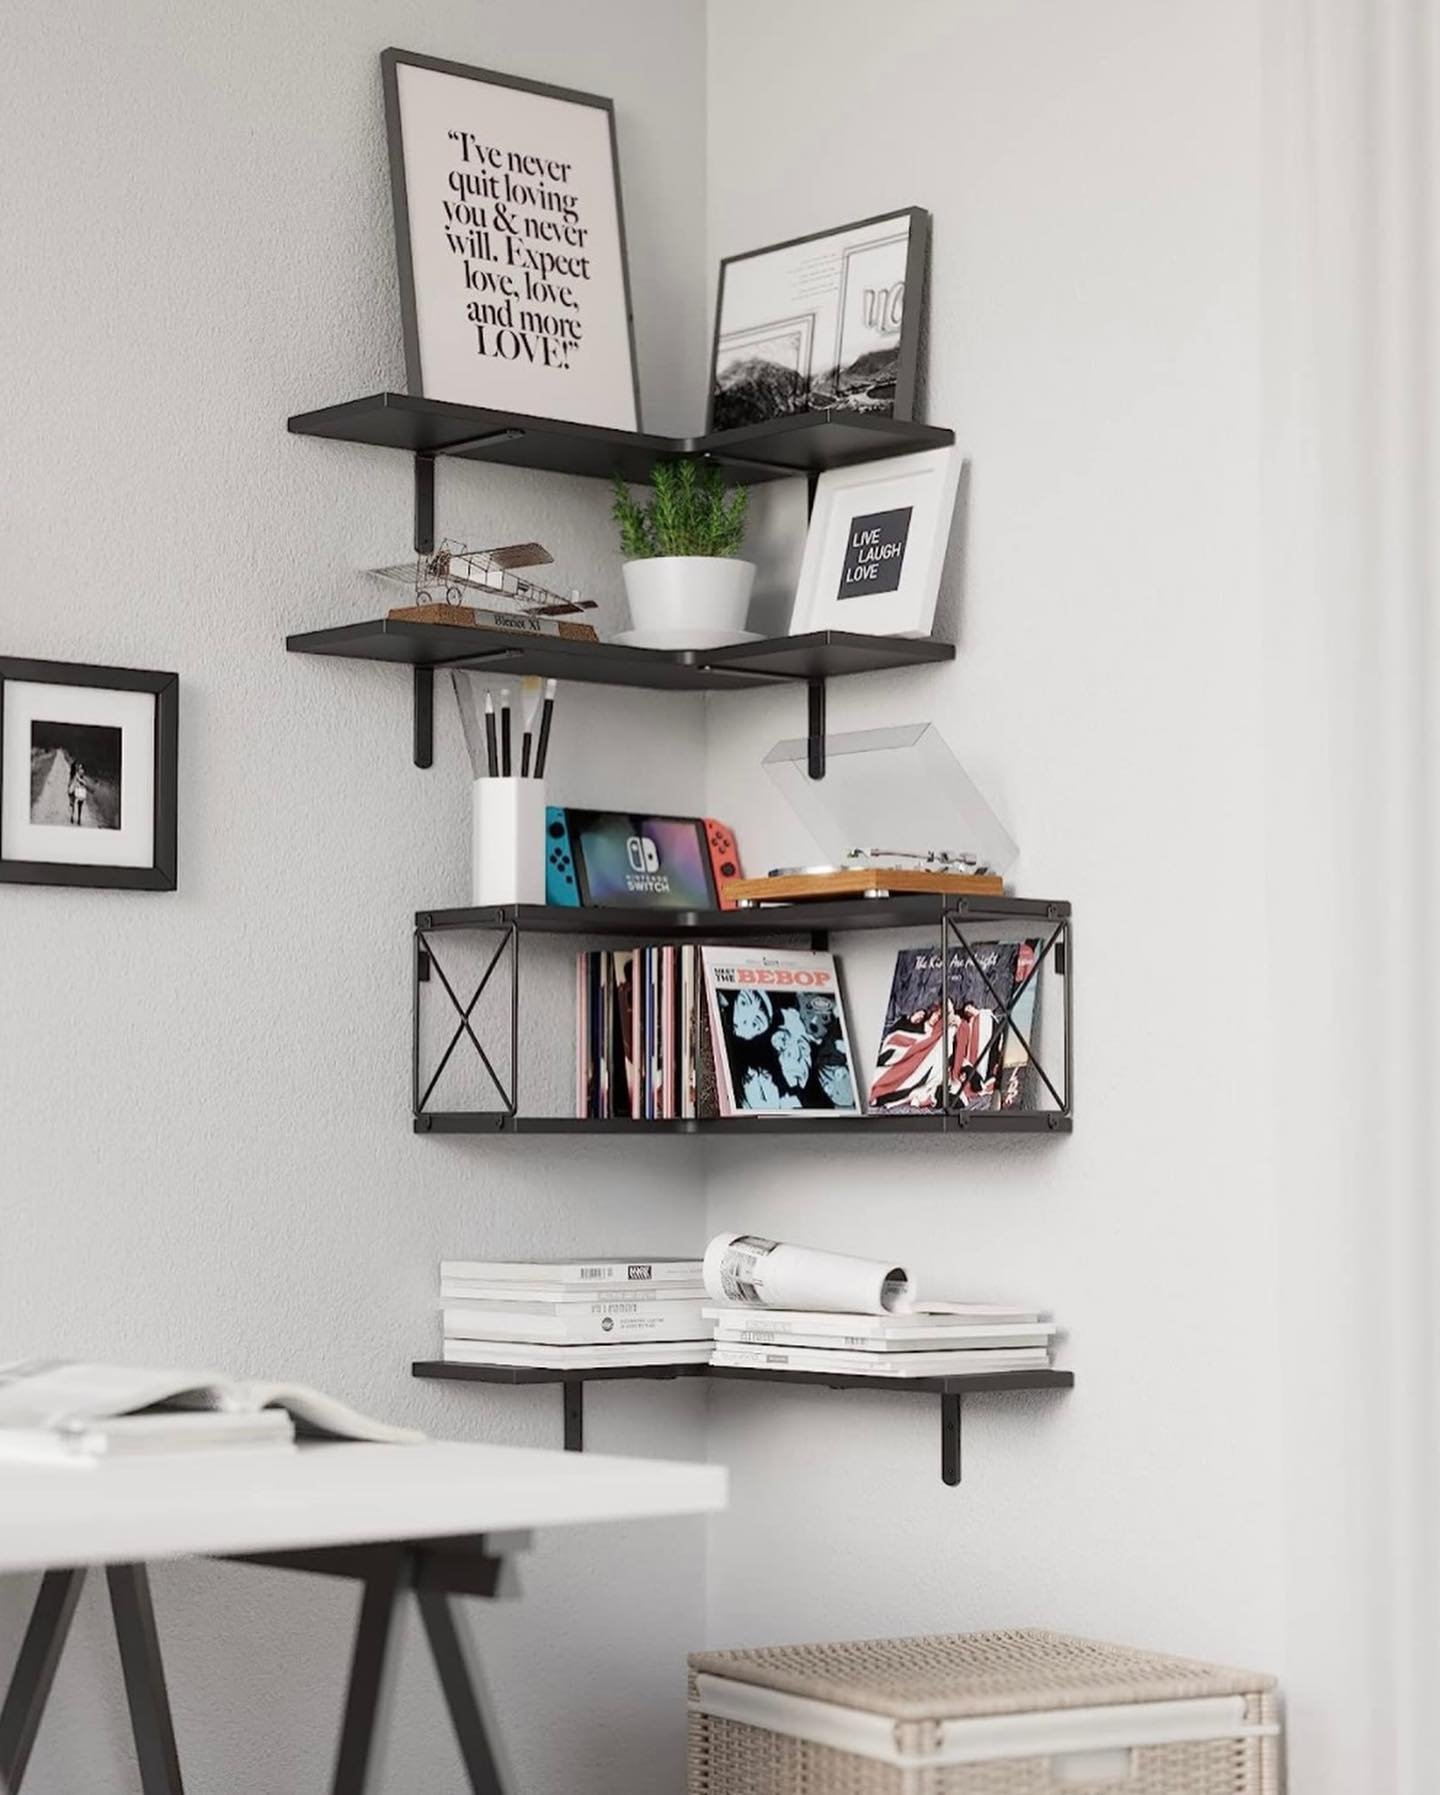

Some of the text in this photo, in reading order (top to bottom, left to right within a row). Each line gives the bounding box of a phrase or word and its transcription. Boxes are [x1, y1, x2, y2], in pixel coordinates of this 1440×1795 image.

[507, 152, 571, 183] never
[448, 169, 578, 225] quit loving
[442, 200, 588, 248] you & never
[446, 229, 590, 280] will. Expect
[464, 260, 579, 313] love, love,
[467, 299, 582, 340] and more
[853, 528, 881, 548] LIVE
[858, 542, 902, 563] LAUGH
[846, 563, 880, 583] LOVE
[627, 881, 670, 893] SWITCH
[716, 974, 736, 983] THE
[737, 967, 832, 986] BEBOP
